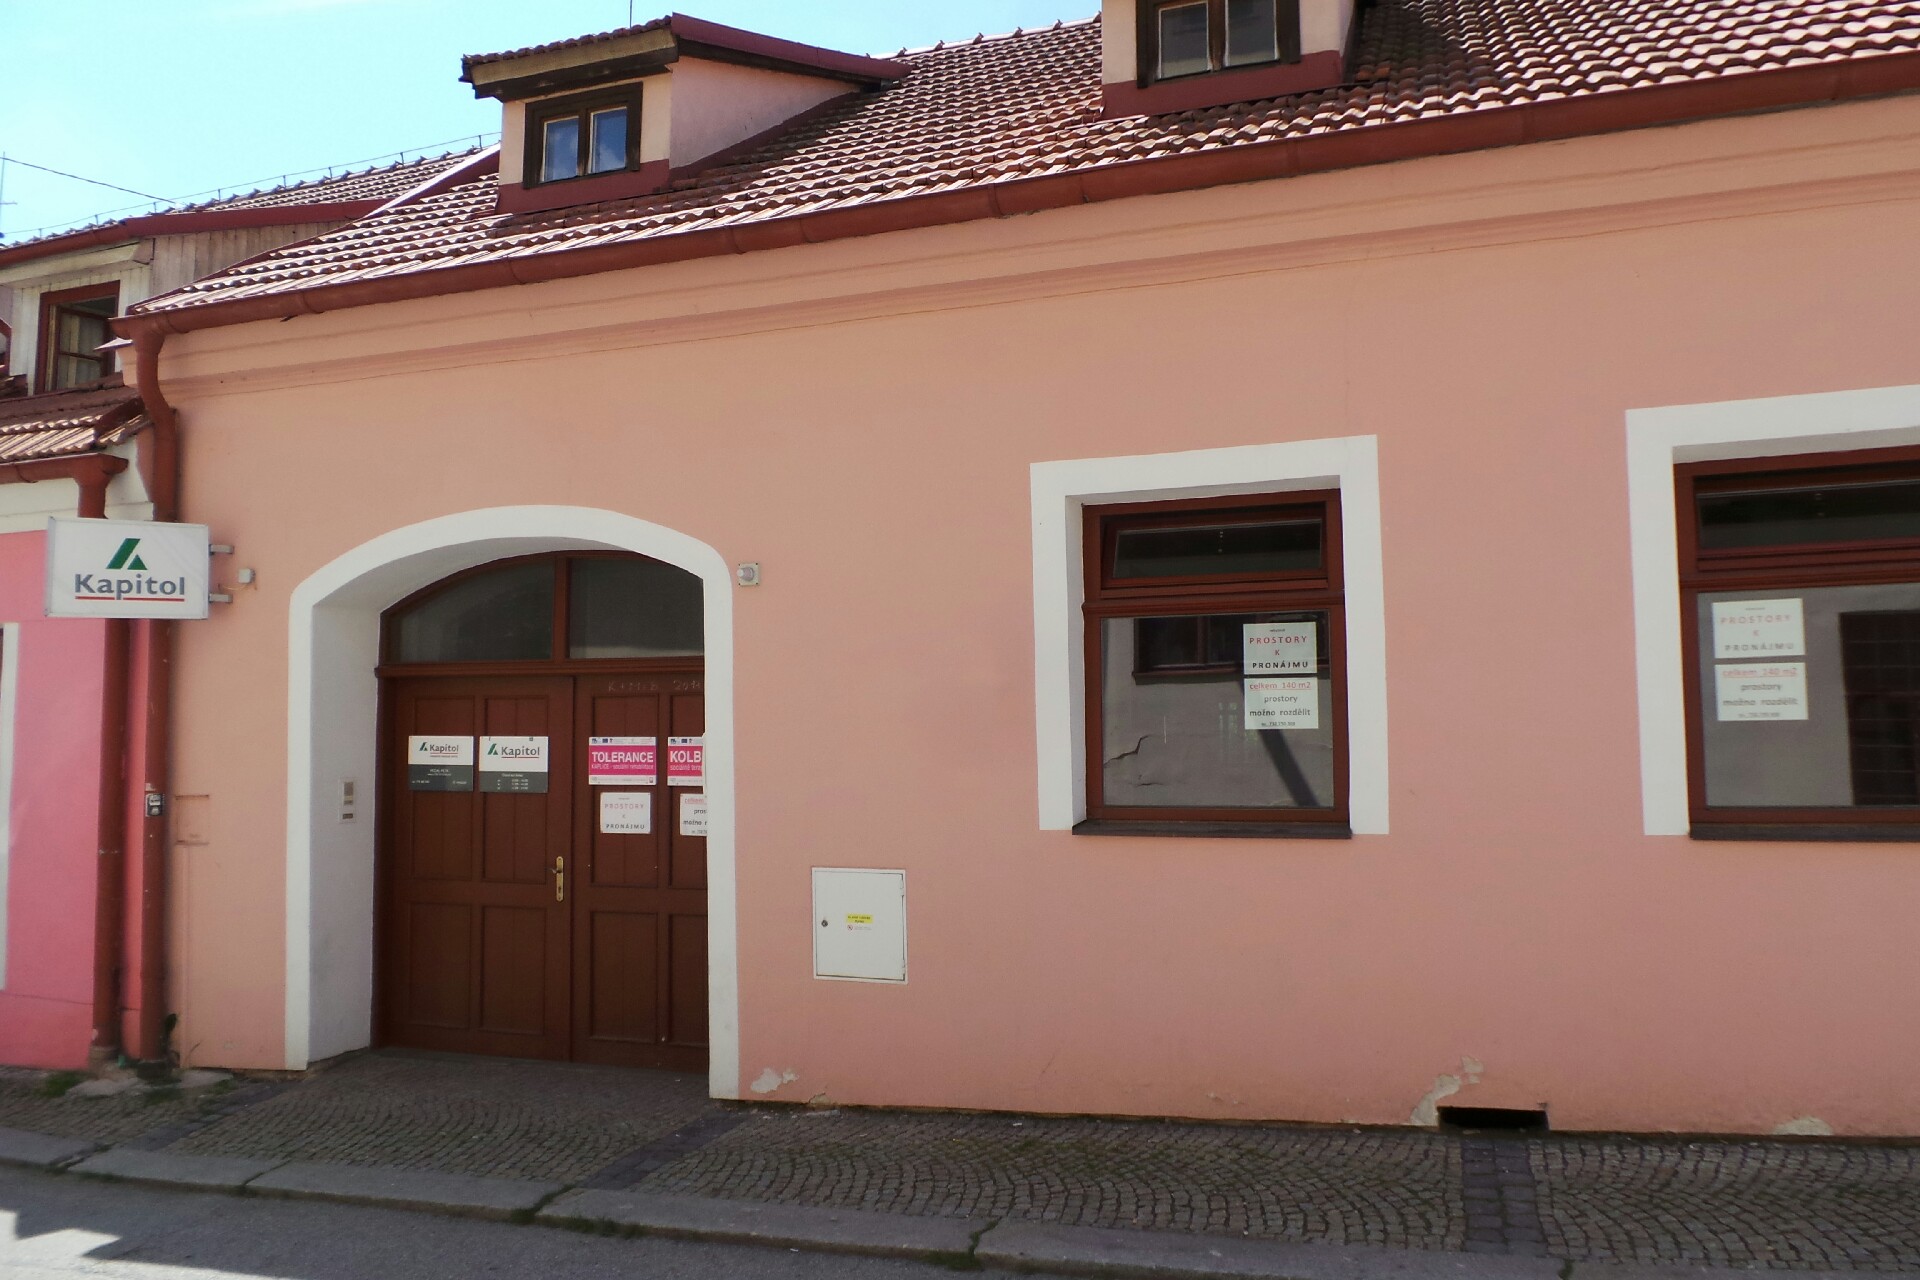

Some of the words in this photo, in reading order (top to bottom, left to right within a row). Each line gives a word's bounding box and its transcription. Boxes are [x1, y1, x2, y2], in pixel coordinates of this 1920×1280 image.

[75, 573, 185, 600] Kapitol
[1720, 615, 1791, 624] PROSTORY
[1249, 636, 1307, 644] PROSTORY
[1252, 660, 1309, 669] PRONÁJMU
[1249, 682, 1278, 690] celkem
[1282, 681, 1297, 689] 140
[1299, 681, 1311, 689] m2
[1280, 708, 1311, 716] rozdělit
[429, 744, 459, 753] Kapitol
[501, 746, 540, 758] Kapitol
[591, 751, 654, 763] TOLERANCE
